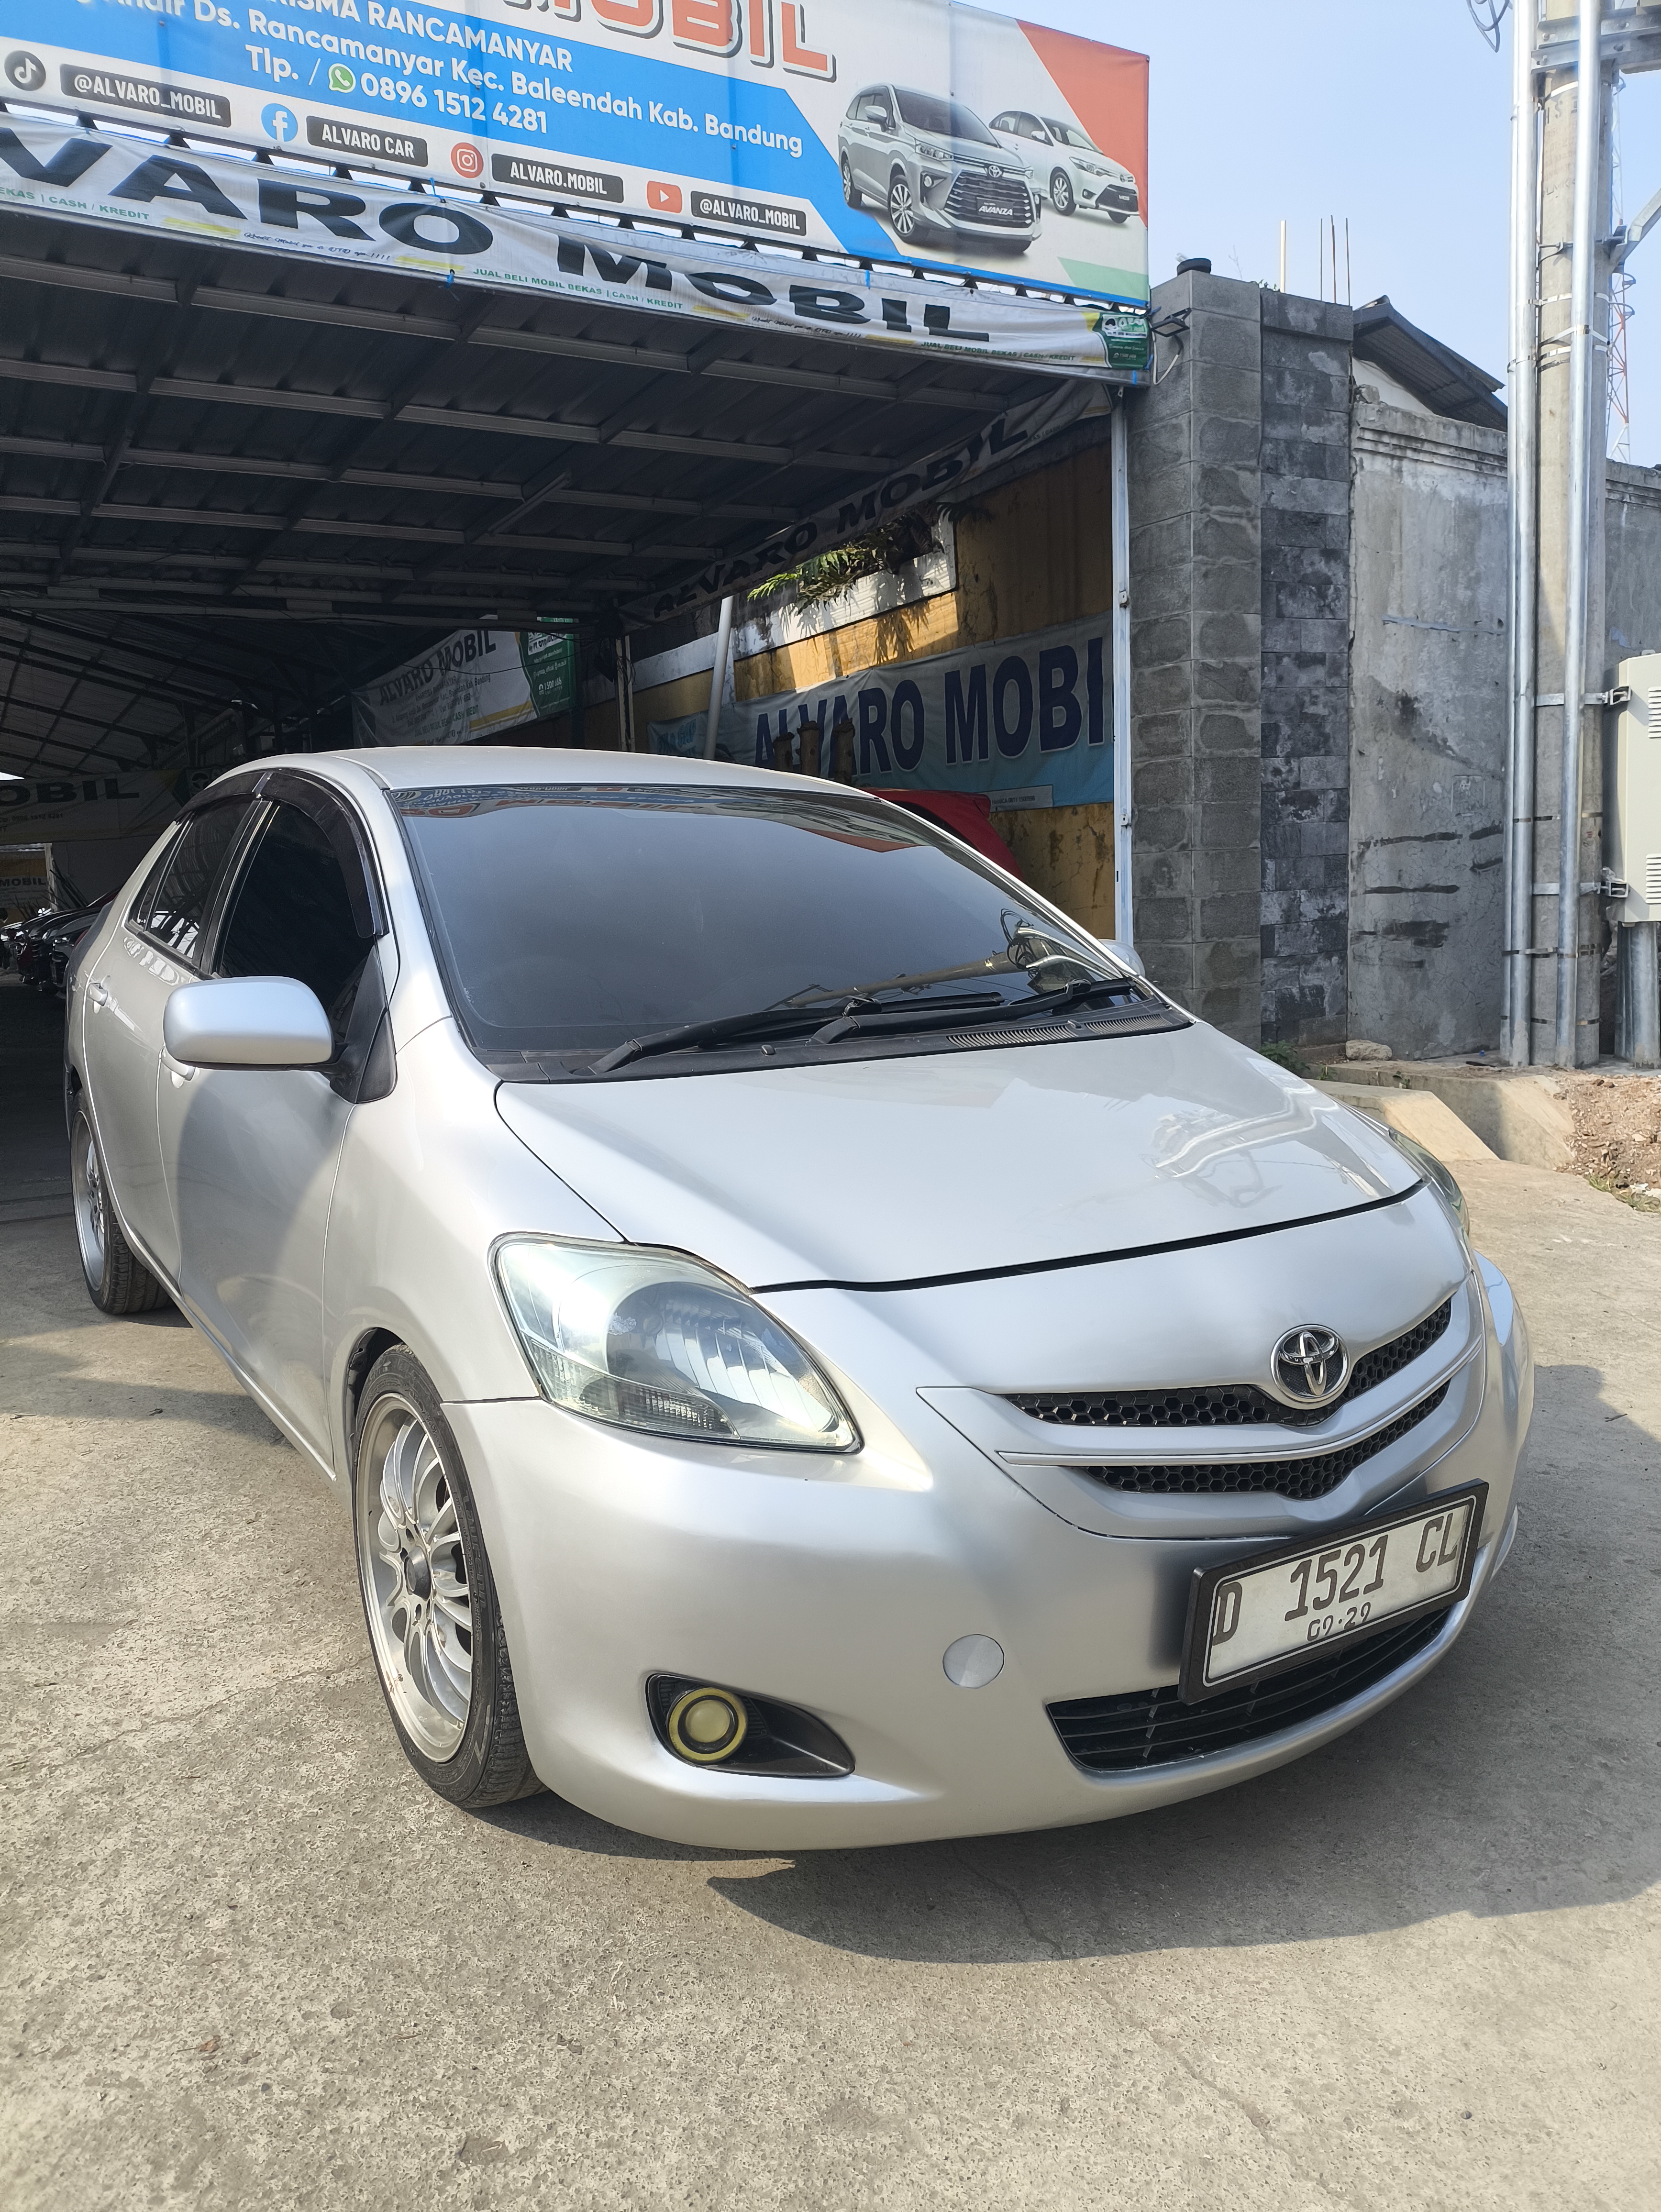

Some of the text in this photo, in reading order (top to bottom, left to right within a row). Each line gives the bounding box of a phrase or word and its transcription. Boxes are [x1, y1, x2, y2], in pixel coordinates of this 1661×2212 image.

[368, 0, 573, 73] RANCAMANYAR
[74, 74, 221, 120] @ALVARO_MOBIL
[245, 44, 299, 83] Tlp.
[360, 72, 427, 108] 0896
[433, 89, 486, 121] 1512
[492, 102, 547, 134] 4281
[248, 8, 444, 77] Rancamanyar
[451, 57, 505, 91] Kec.
[511, 71, 642, 120] Baleendah
[649, 101, 698, 132] Kab.
[705, 113, 803, 158] Bandung
[321, 123, 415, 159] ALVARO CAR
[510, 161, 608, 195] ALVARO.MOBIL
[48, 196, 87, 210] CASH
[99, 205, 150, 220] KREDIT
[699, 198, 800, 231] @ALVARO_MOBIL
[978, 205, 1013, 216] AVANZA
[473, 267, 501, 278] JUAL
[504, 273, 528, 283] BELI
[531, 276, 565, 288] MOBIL
[567, 283, 602, 295] BEKAS
[612, 291, 639, 301] CASH
[646, 298, 683, 310] KREDIT
[557, 234, 990, 343] MOBIL
[963, 346, 989, 354] MOBIL
[436, 630, 496, 676] MOBIL
[944, 637, 1104, 765] MOBI
[0, 877, 46, 887] MOBIL
[1211, 1513, 1458, 1646] D 1521 CL
